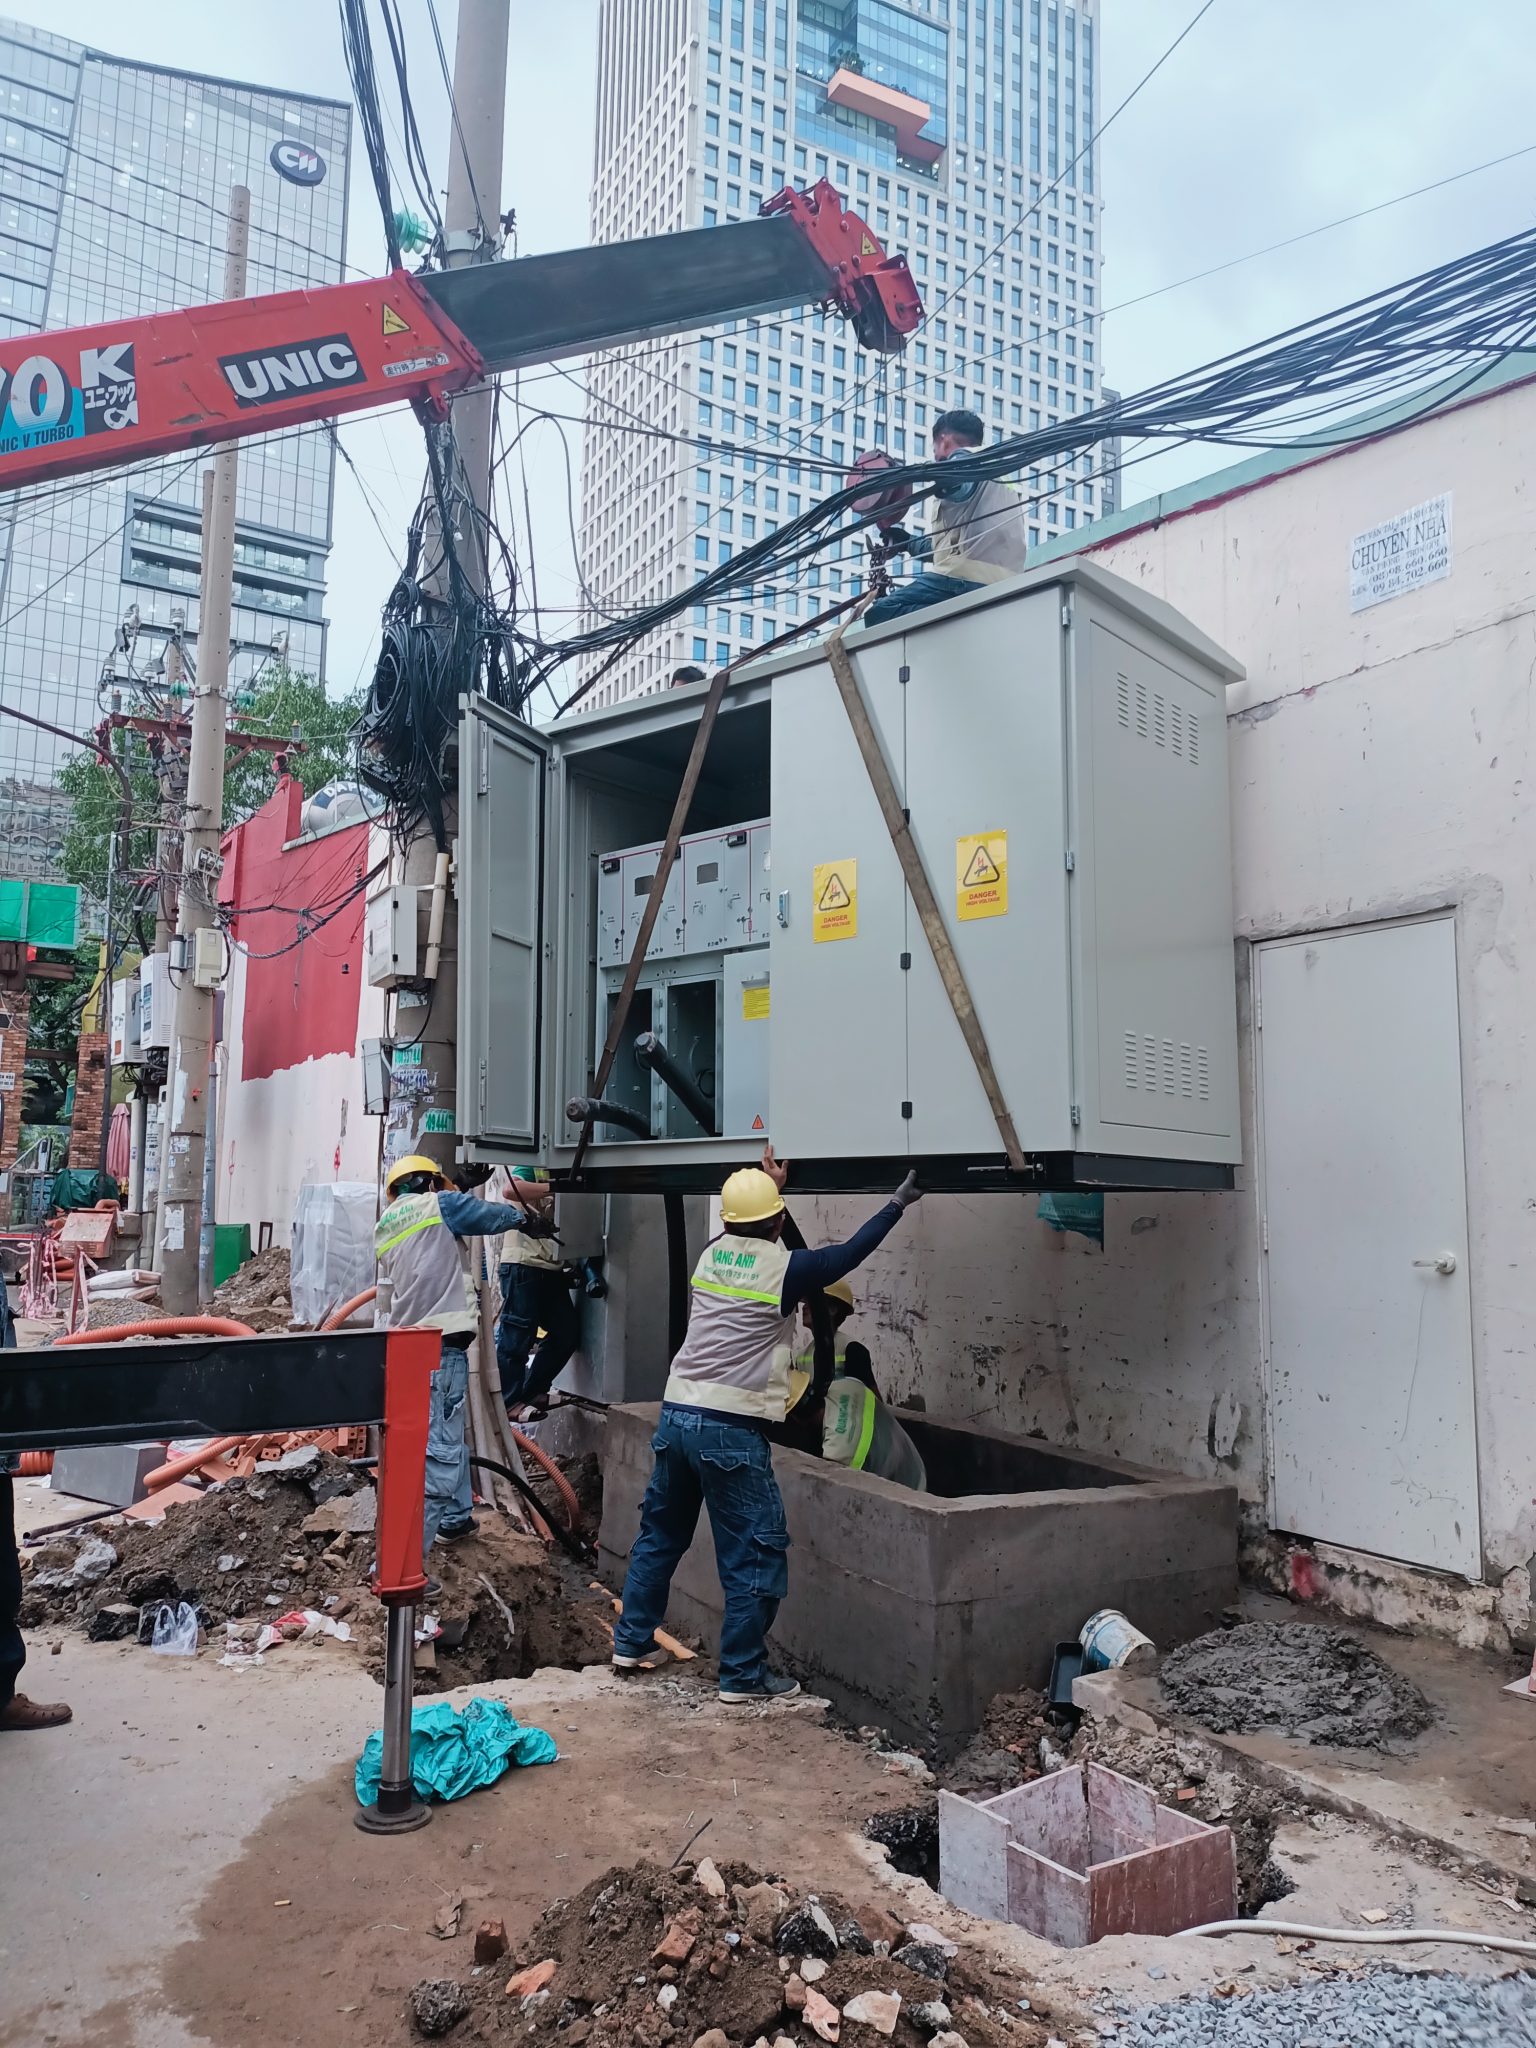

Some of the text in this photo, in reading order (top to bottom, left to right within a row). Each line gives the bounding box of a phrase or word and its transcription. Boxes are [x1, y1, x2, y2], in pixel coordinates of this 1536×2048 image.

[224, 343, 358, 398] UNIC
[23, 434, 30, 448] V
[35, 424, 74, 445] TURBO
[969, 890, 996, 900] DANGER
[824, 914, 848, 924] DANGER
[735, 1253, 756, 1269] ANH
